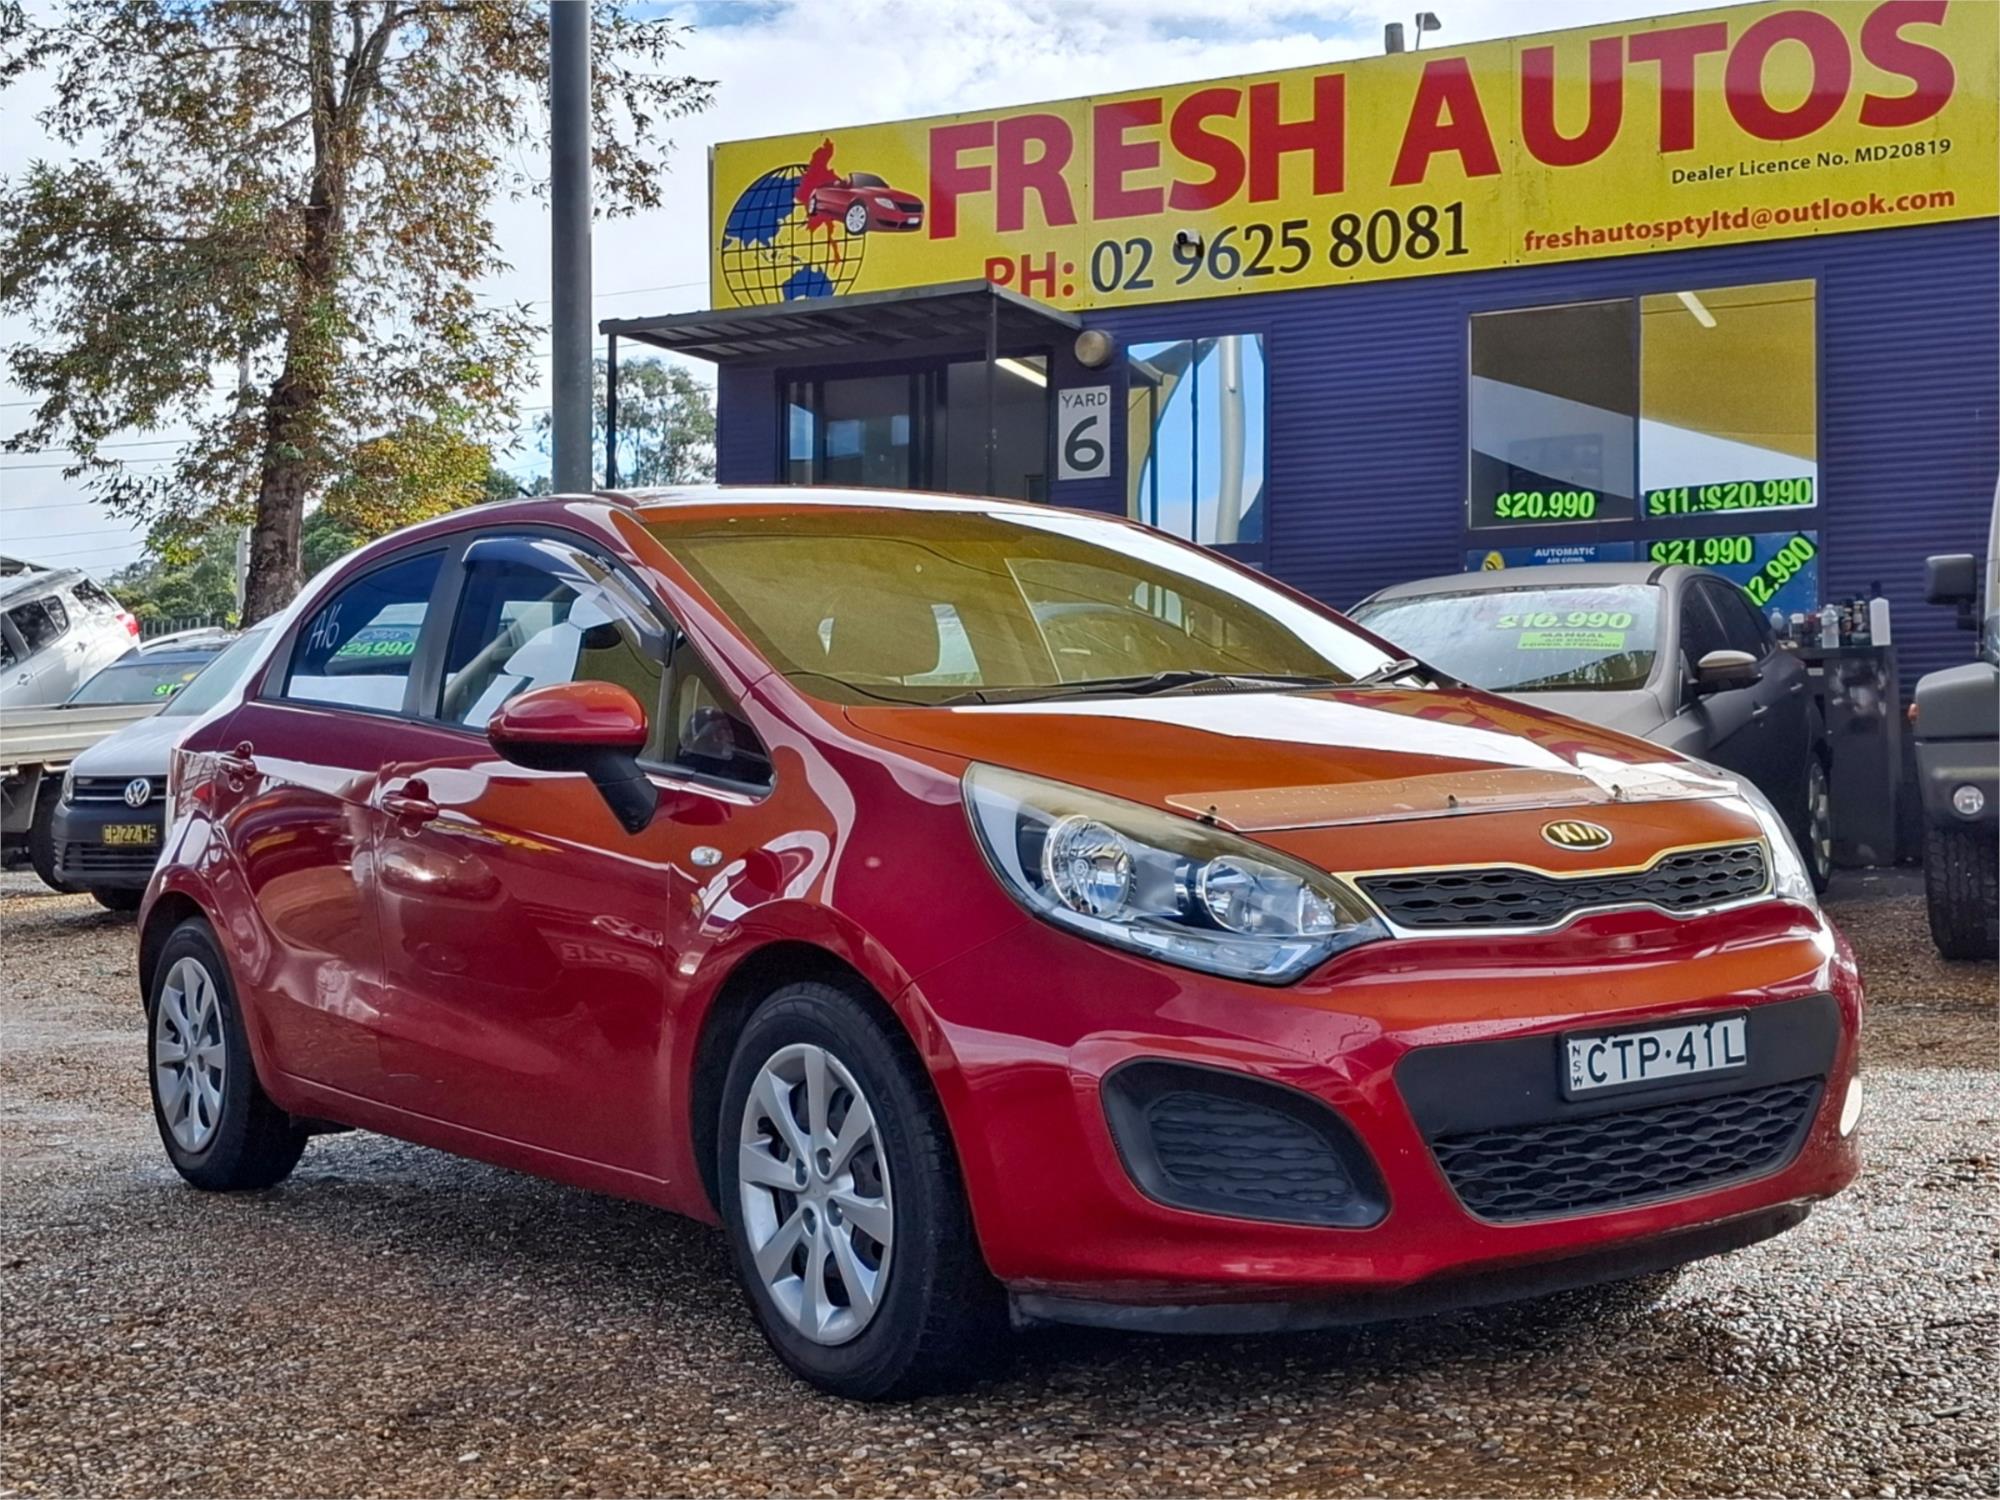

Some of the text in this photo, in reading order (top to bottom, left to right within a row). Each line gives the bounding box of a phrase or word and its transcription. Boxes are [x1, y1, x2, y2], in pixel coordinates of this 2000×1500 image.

[929, 0, 1955, 239] FRESH AUTOS
[1672, 139, 1951, 184] Dealer Licence No. MD20819
[1525, 190, 1955, 250] freshautosptyltd@outlook.com
[985, 201, 1469, 298] PH: 02 9625 8081
[1062, 392, 1108, 408] YARD
[1065, 415, 1105, 472] 6
[1534, 547, 1596, 557] AUTOMATIC
[1549, 823, 1607, 843] KIA
